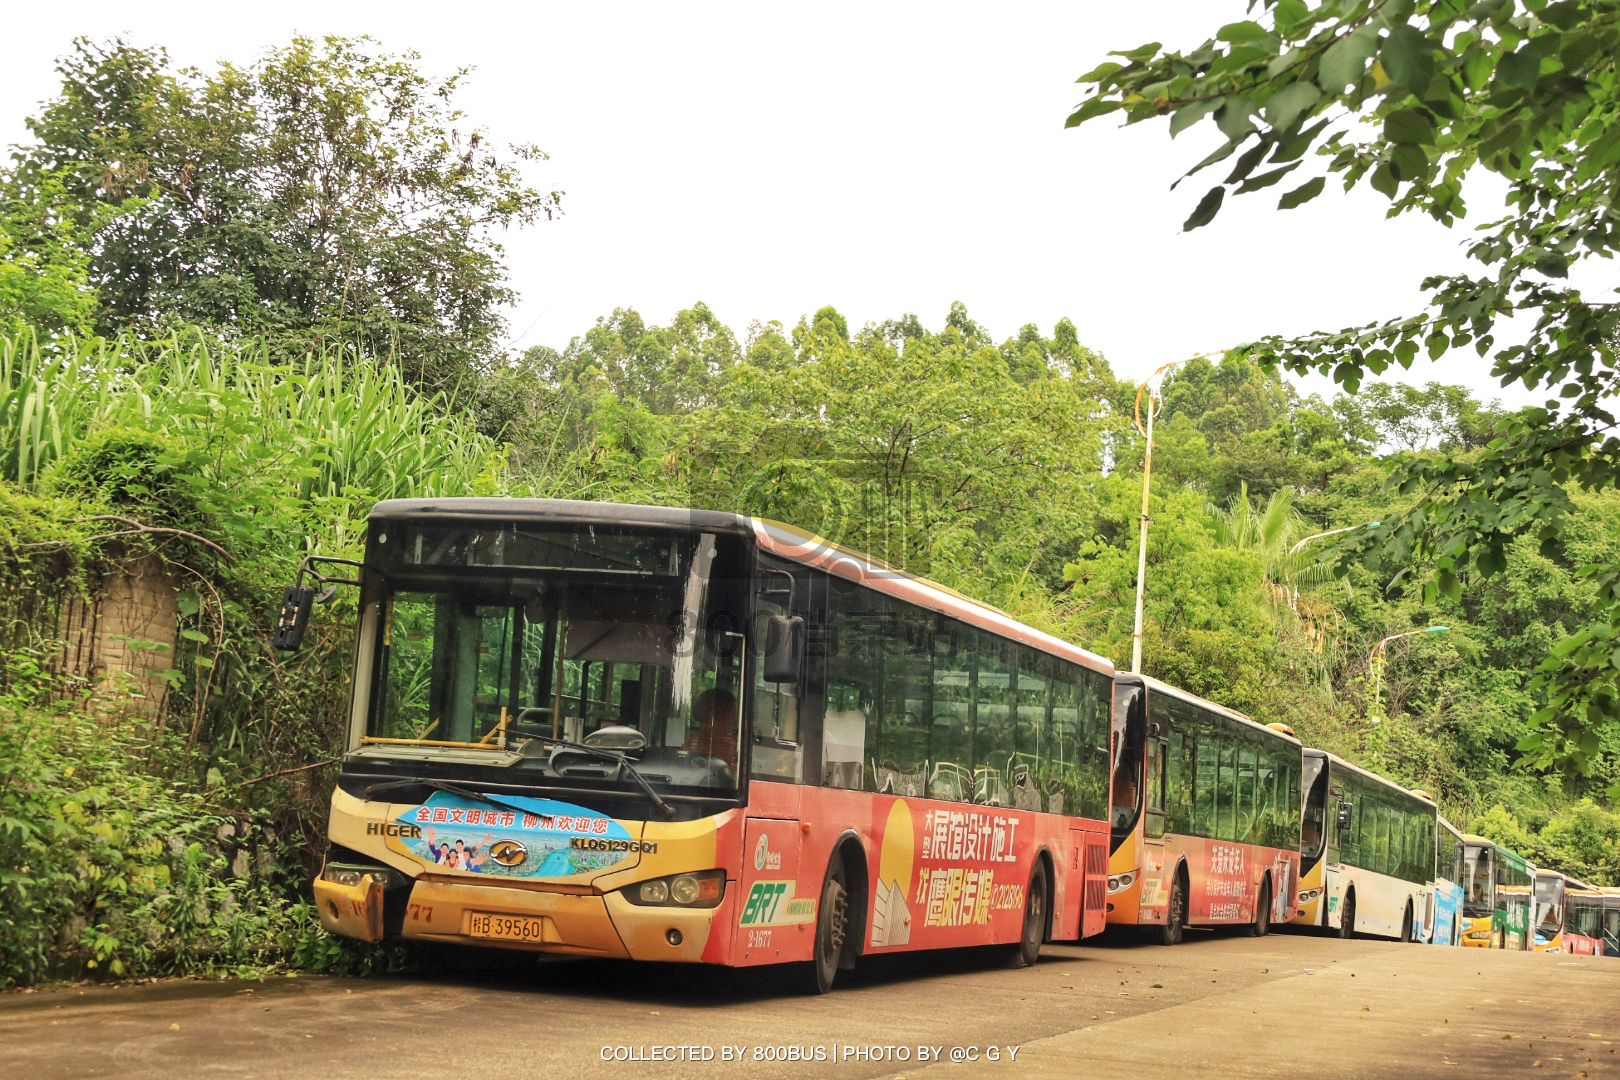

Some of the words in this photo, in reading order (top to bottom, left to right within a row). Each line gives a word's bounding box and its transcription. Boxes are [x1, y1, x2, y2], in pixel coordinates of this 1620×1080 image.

[366, 822, 422, 839] HIGER
[415, 806, 516, 828] 全国文明城市
[523, 813, 609, 835] 柳州欢迎您
[740, 883, 787, 924] BRT
